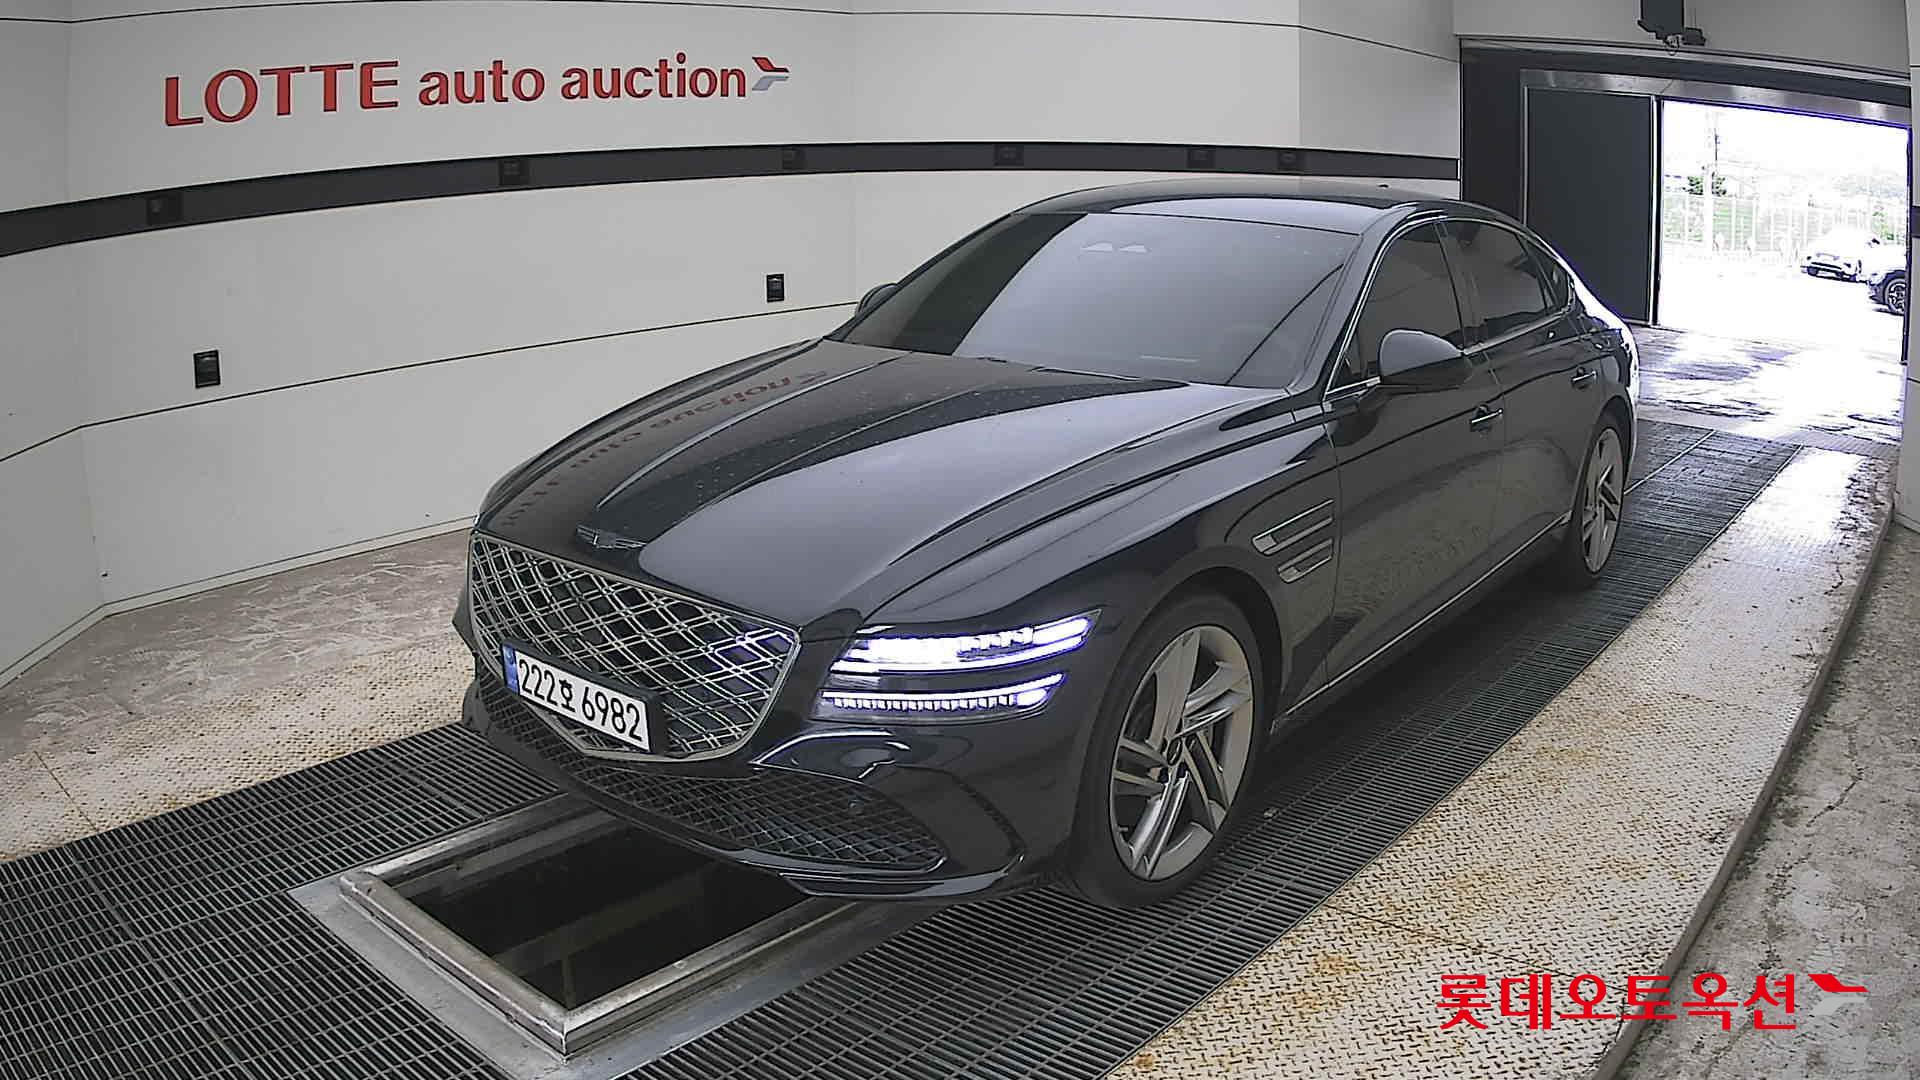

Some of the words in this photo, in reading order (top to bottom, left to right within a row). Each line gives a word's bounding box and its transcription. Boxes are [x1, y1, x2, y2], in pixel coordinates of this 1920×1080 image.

[164, 59, 399, 127] LOTTE
[417, 59, 545, 106] auto
[560, 52, 747, 100] auction
[519, 659, 576, 712] 222호
[582, 686, 643, 742] 6982
